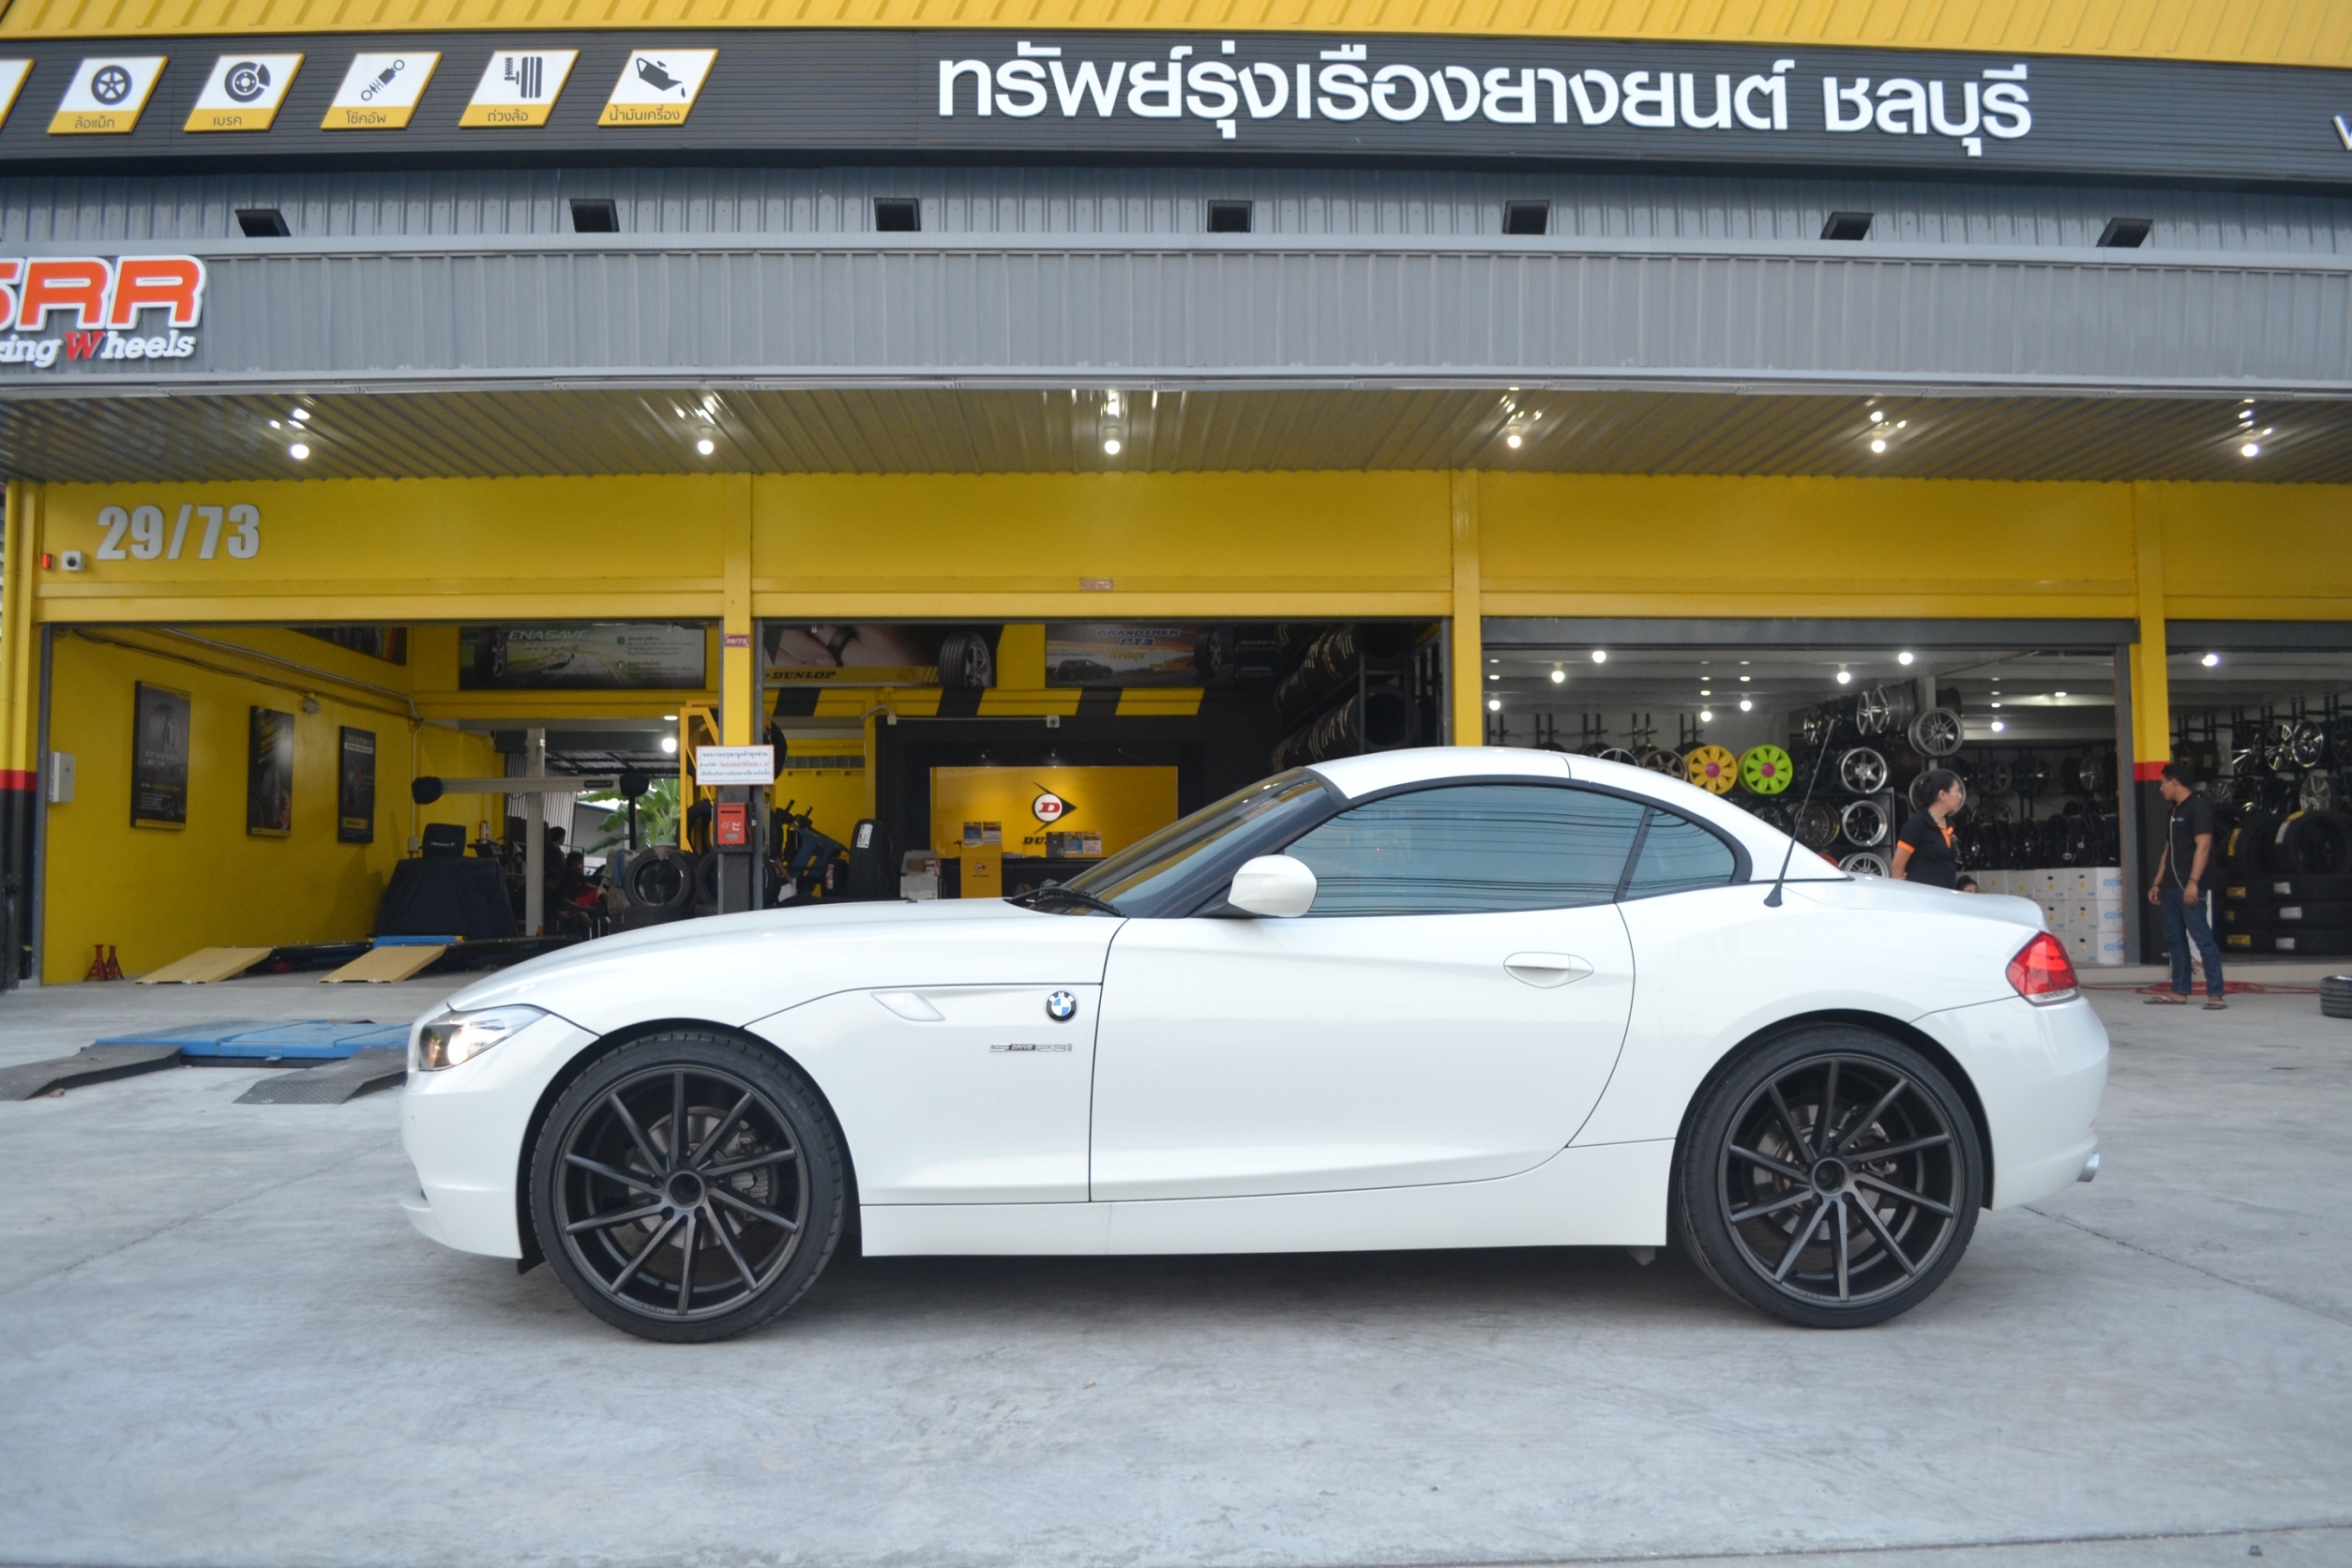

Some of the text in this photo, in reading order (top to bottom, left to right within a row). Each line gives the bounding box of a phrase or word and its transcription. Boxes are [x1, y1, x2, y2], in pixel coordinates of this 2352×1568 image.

[610, 104, 681, 121] น้ำมันเครื่อง
[939, 39, 2033, 157] ทรัพย์รุ่งเรืองยางยนต์ ชลบุรี
[488, 108, 529, 122] ถ่วงล้อ
[0, 254, 207, 331] RR
[65, 329, 197, 360] Wheels
[96, 504, 261, 561] 29/73
[508, 630, 590, 641] ENASAVE
